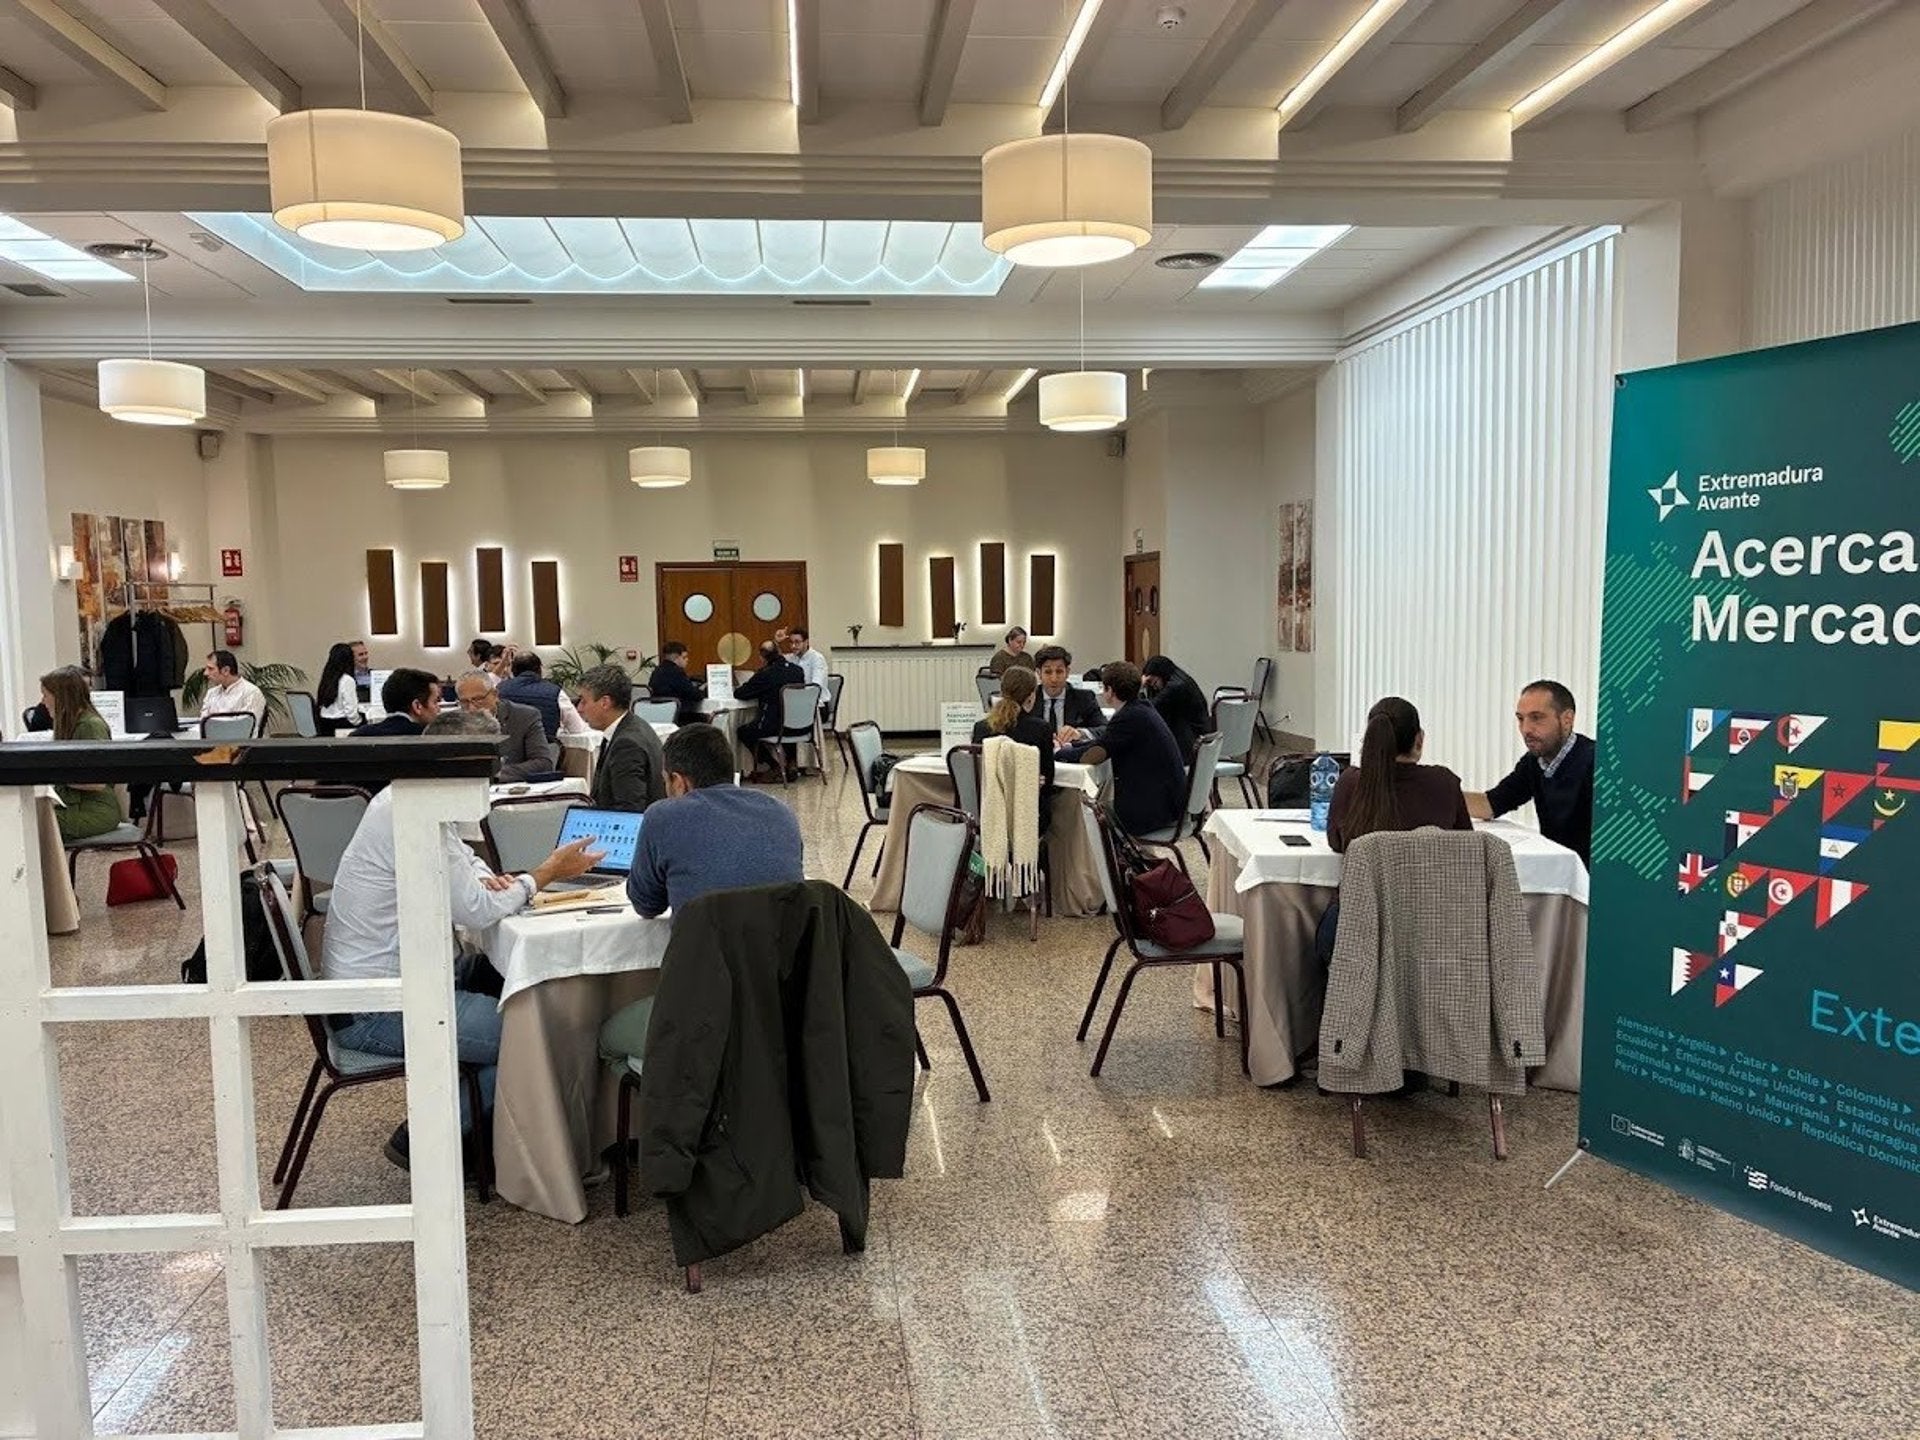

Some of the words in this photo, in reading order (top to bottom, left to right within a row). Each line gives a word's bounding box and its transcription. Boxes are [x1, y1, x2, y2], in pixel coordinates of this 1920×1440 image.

[1697, 492, 1761, 511] Avante
[1699, 465, 1824, 492] Extremadura
[1690, 529, 1919, 579] Acerca
[1811, 989, 1920, 1055] Exte
[1616, 1015, 1665, 1038] Alemania
[1678, 1034, 1717, 1055] Argelia
[1735, 1051, 1767, 1070] Catar
[1787, 1068, 1820, 1087] Chile
[1836, 1083, 1899, 1112] Colombia
[1616, 1029, 1659, 1049] Ecuador
[1675, 1048, 1725, 1073] Emiratos
[1728, 1063, 1769, 1087] Árabes
[1773, 1080, 1815, 1102] Unidos
[1836, 1100, 1889, 1126] Estados
[1614, 1058, 1638, 1075] Perú
[1652, 1071, 1696, 1095] Portugal
[1710, 1091, 1743, 1110] Reino
[1746, 1103, 1781, 1124] Unido
[1801, 1121, 1865, 1154] República
[1615, 1044, 1671, 1070] Guatemala
[1685, 1066, 1745, 1096] Marruecos
[1764, 1093, 1830, 1124] Mauritania
[1851, 1122, 1918, 1154] Nicaragua
[1770, 1181, 1796, 1198] Fondos
[1797, 1190, 1833, 1212] Europeos
